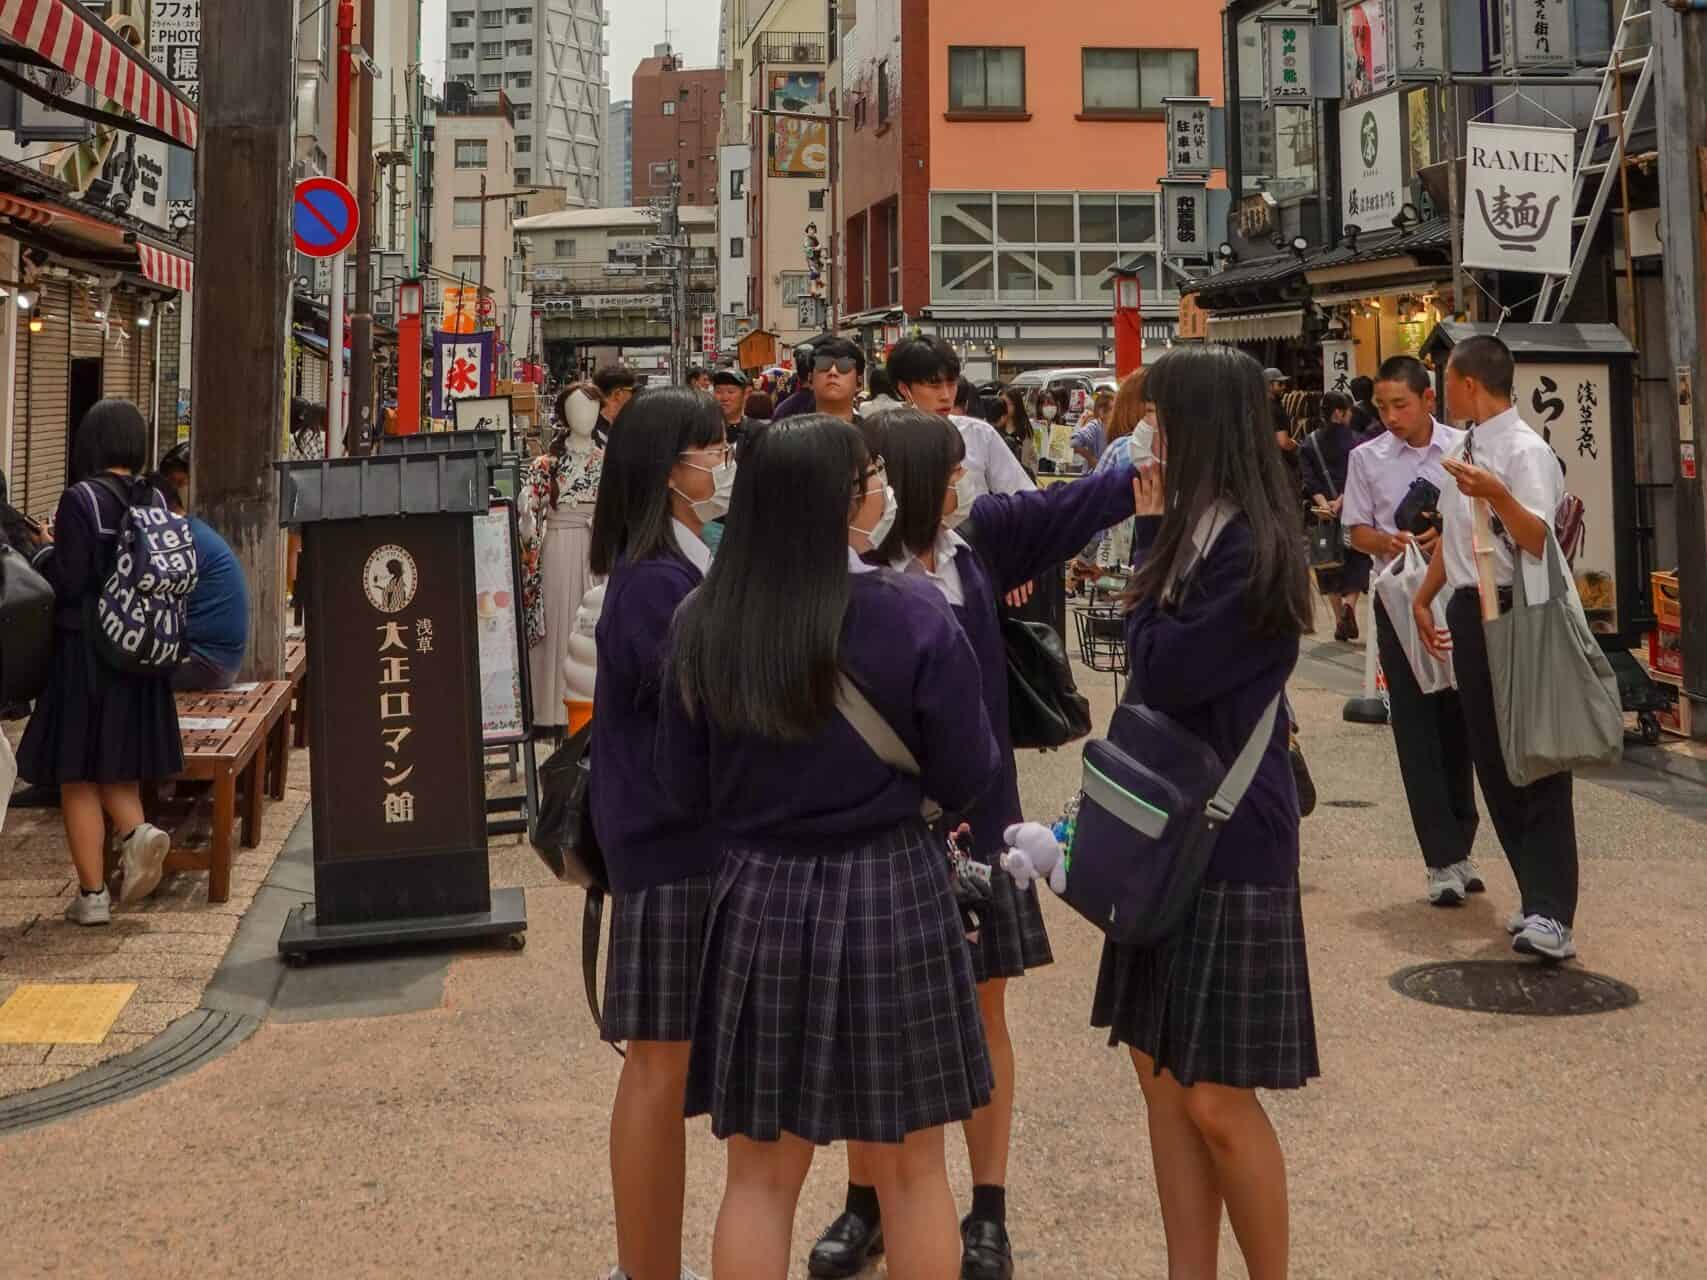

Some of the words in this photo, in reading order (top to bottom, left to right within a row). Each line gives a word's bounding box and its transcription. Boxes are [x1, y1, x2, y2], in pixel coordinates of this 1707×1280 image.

[1471, 146, 1569, 174] RAMEN
[444, 357, 478, 393] 氷
[1576, 379, 1598, 460] 浅草名代
[416, 618, 433, 654] 浅草
[376, 621, 415, 823] 大正ロマン館
